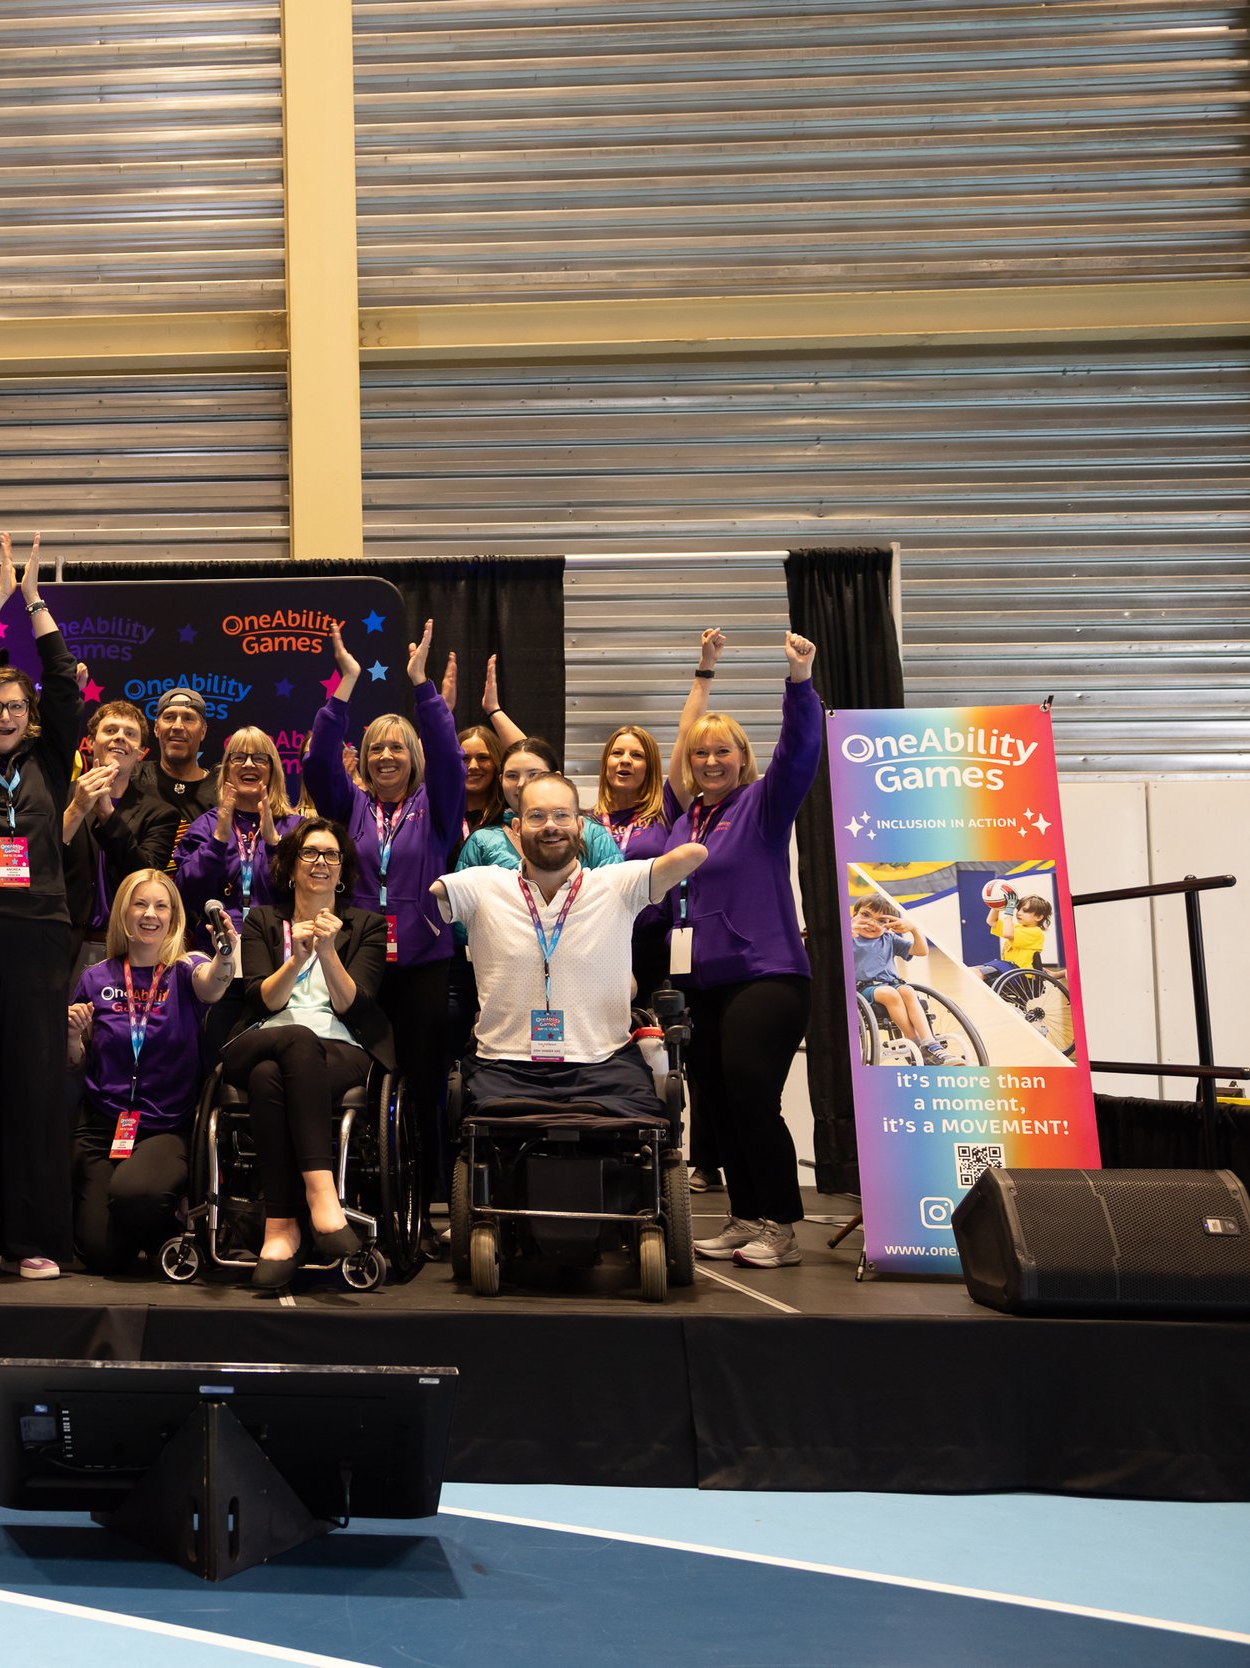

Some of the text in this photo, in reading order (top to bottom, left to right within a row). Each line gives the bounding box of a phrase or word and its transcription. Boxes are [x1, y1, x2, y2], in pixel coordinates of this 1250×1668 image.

[32, 617, 155, 644] neAbility
[222, 609, 346, 637] OneAbility
[70, 643, 132, 661] ames
[242, 634, 322, 655] Games
[124, 673, 252, 702] OneAbility
[145, 700, 228, 720] Ges
[841, 727, 1038, 766] OneAbility
[875, 765, 1004, 793] Games
[876, 817, 1017, 829] INCLUSION IN ACTION
[937, 1076, 990, 1088] more
[998, 1073, 1046, 1089] than
[914, 1097, 1026, 1114] a moment,
[923, 1121, 934, 1133] a
[942, 1119, 1069, 1135] MOVEMENT!
[884, 1245, 958, 1256] www.one
